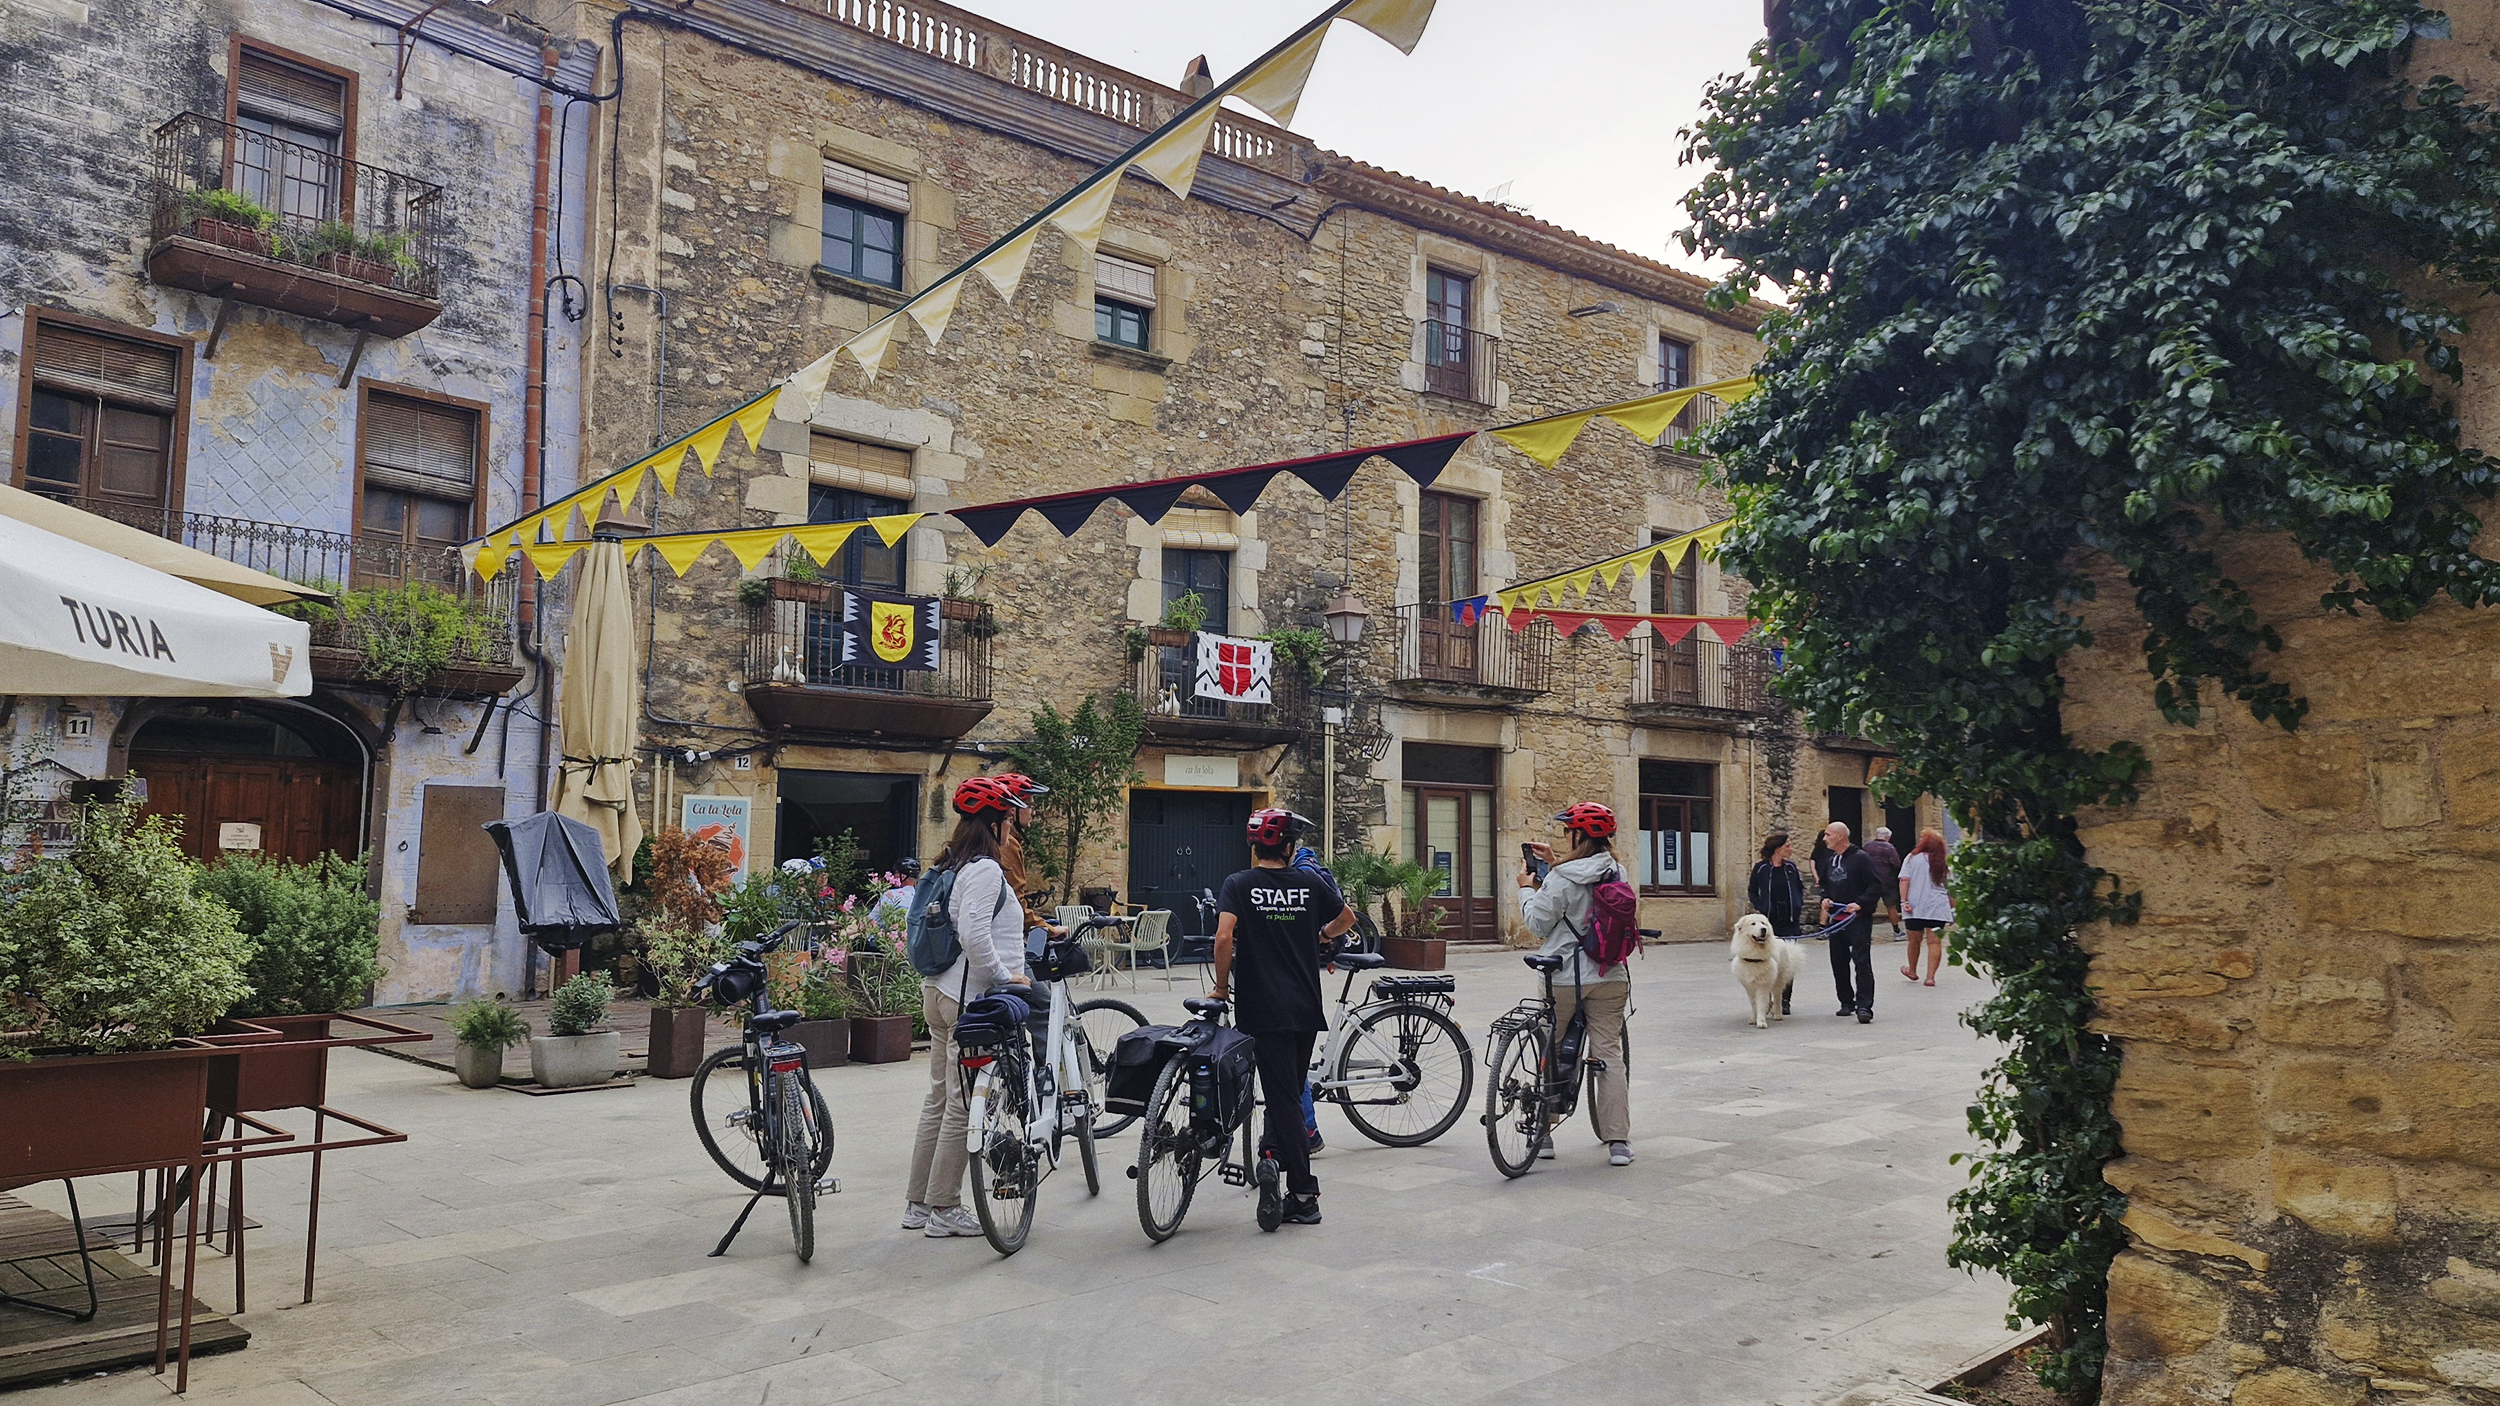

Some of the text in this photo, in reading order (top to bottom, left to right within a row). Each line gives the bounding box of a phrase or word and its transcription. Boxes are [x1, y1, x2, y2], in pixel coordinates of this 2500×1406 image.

[59, 594, 176, 663] TURIA
[69, 719, 88, 734] 11
[736, 757, 749, 768] 12
[692, 803, 742, 818] Ca la Lola
[1250, 887, 1310, 905] STAFF
